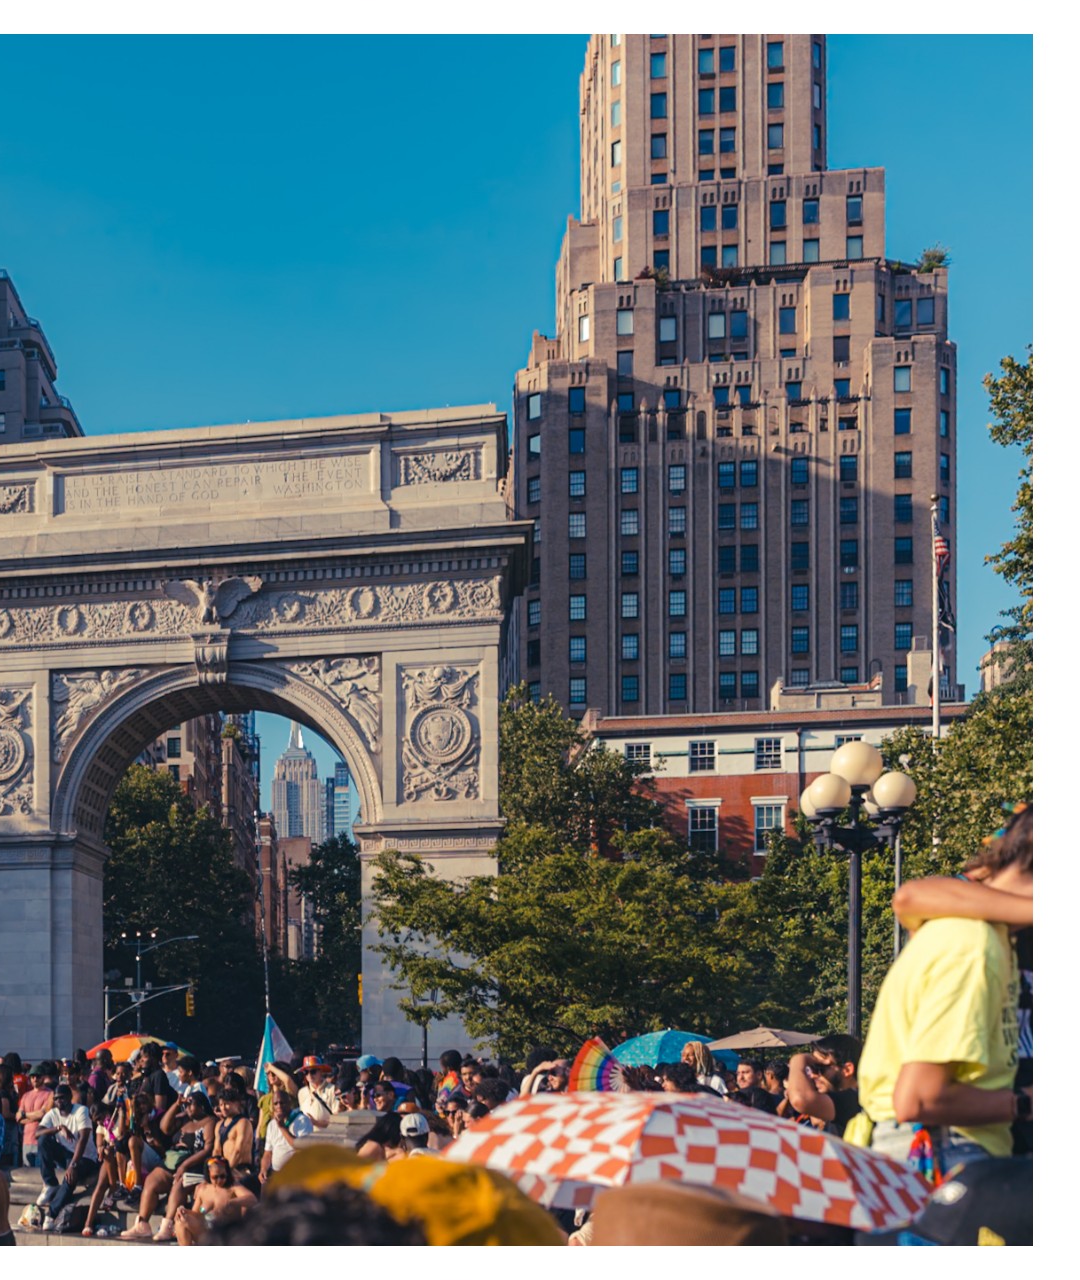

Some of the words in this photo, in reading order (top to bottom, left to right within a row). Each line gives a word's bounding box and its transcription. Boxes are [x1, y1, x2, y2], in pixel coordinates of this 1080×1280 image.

[65, 477, 88, 488] LET
[92, 476, 104, 487] US
[108, 473, 141, 486] RAISE
[147, 473, 157, 482] A
[160, 467, 228, 481] STANDARD
[232, 465, 250, 475] TO
[254, 462, 296, 474] WHICH
[301, 459, 326, 470] THE
[330, 457, 361, 468] WISE
[65, 488, 90, 499] AND
[95, 486, 119, 497] THE
[125, 482, 176, 495] HONEST
[183, 479, 213, 490] CAN
[217, 475, 262, 488] REPAIR
[283, 472, 309, 483] THE
[317, 468, 362, 481] EVENT
[65, 500, 75, 510] IS
[80, 499, 91, 509] IN
[97, 496, 120, 507] THE
[127, 494, 164, 505] HAND
[169, 492, 186, 503] OF
[191, 488, 219, 500] GOD
[273, 479, 363, 495] WASHINGTON
